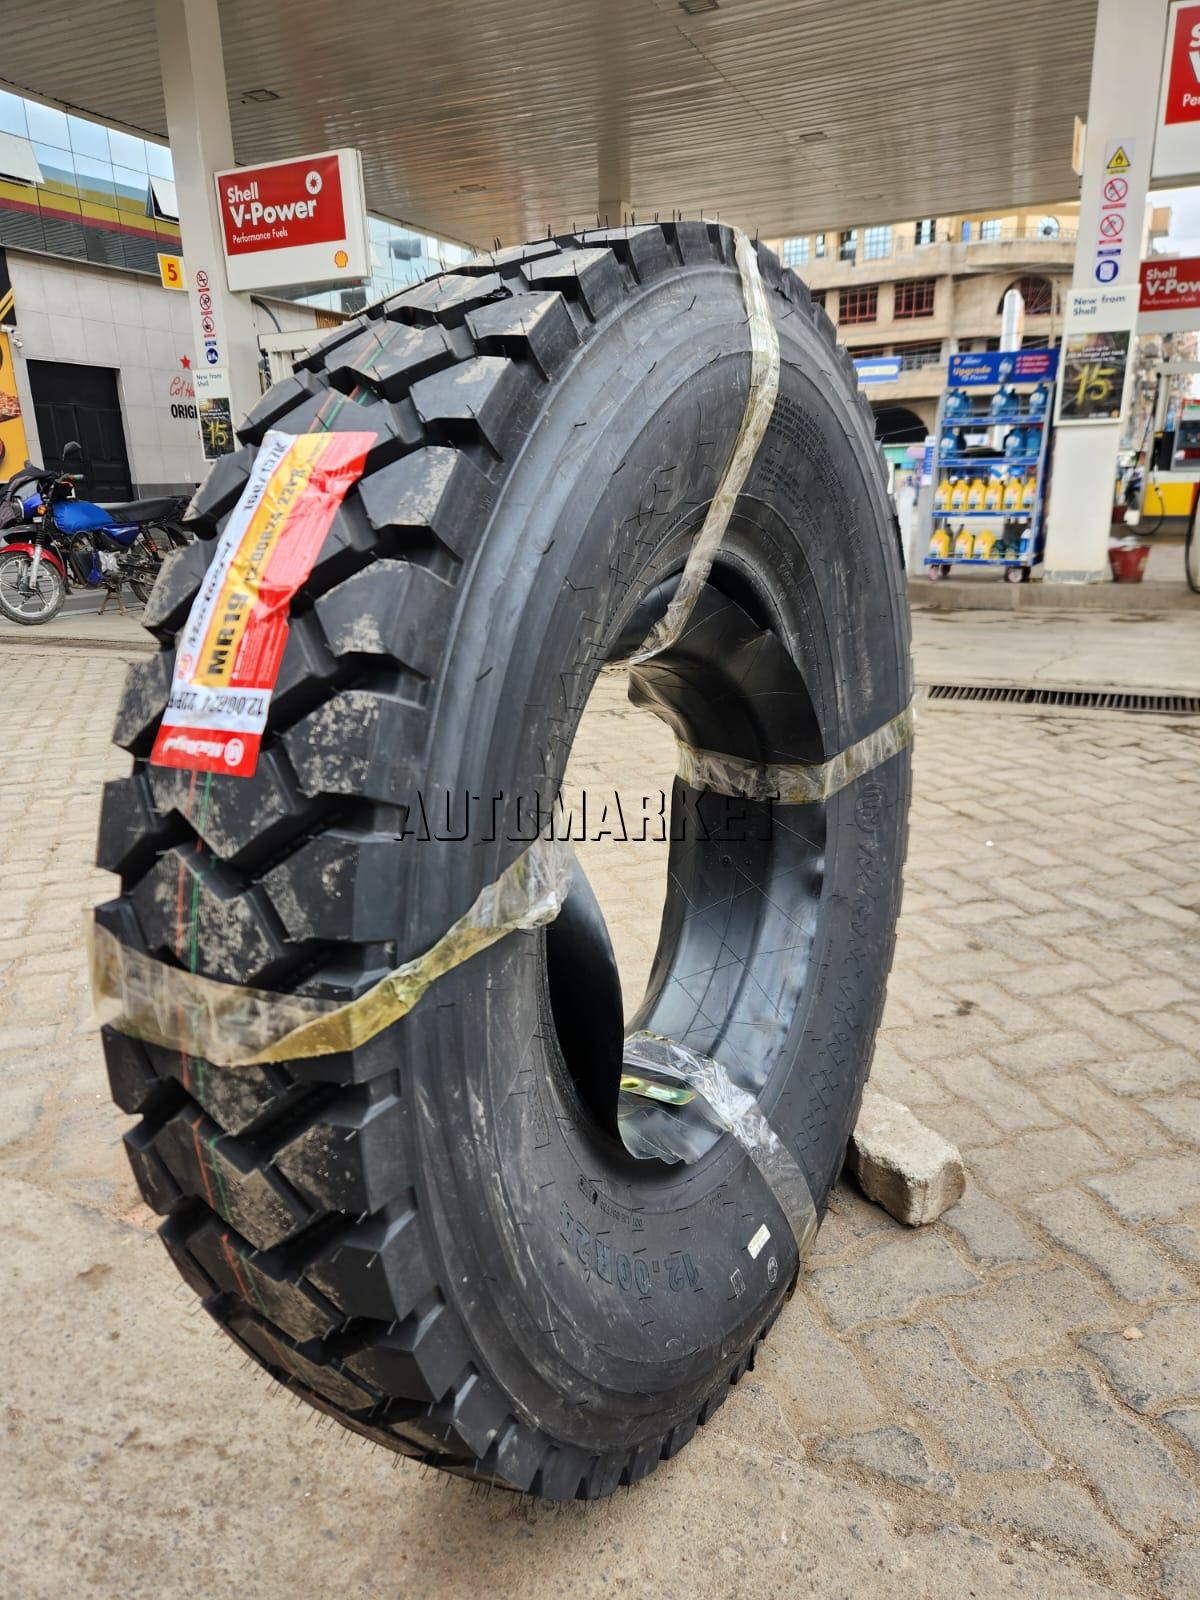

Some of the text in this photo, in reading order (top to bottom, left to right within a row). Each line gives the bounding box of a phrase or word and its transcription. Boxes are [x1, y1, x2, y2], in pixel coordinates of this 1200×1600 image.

[227, 181, 259, 204] Shell
[229, 199, 317, 228] V-Power
[232, 227, 288, 244] Performance Fuels
[167, 263, 178, 282] 5
[1145, 266, 1177, 281] Shell
[1073, 294, 1126, 305] New from
[1073, 306, 1097, 316] Shell
[207, 592, 250, 676] MR19
